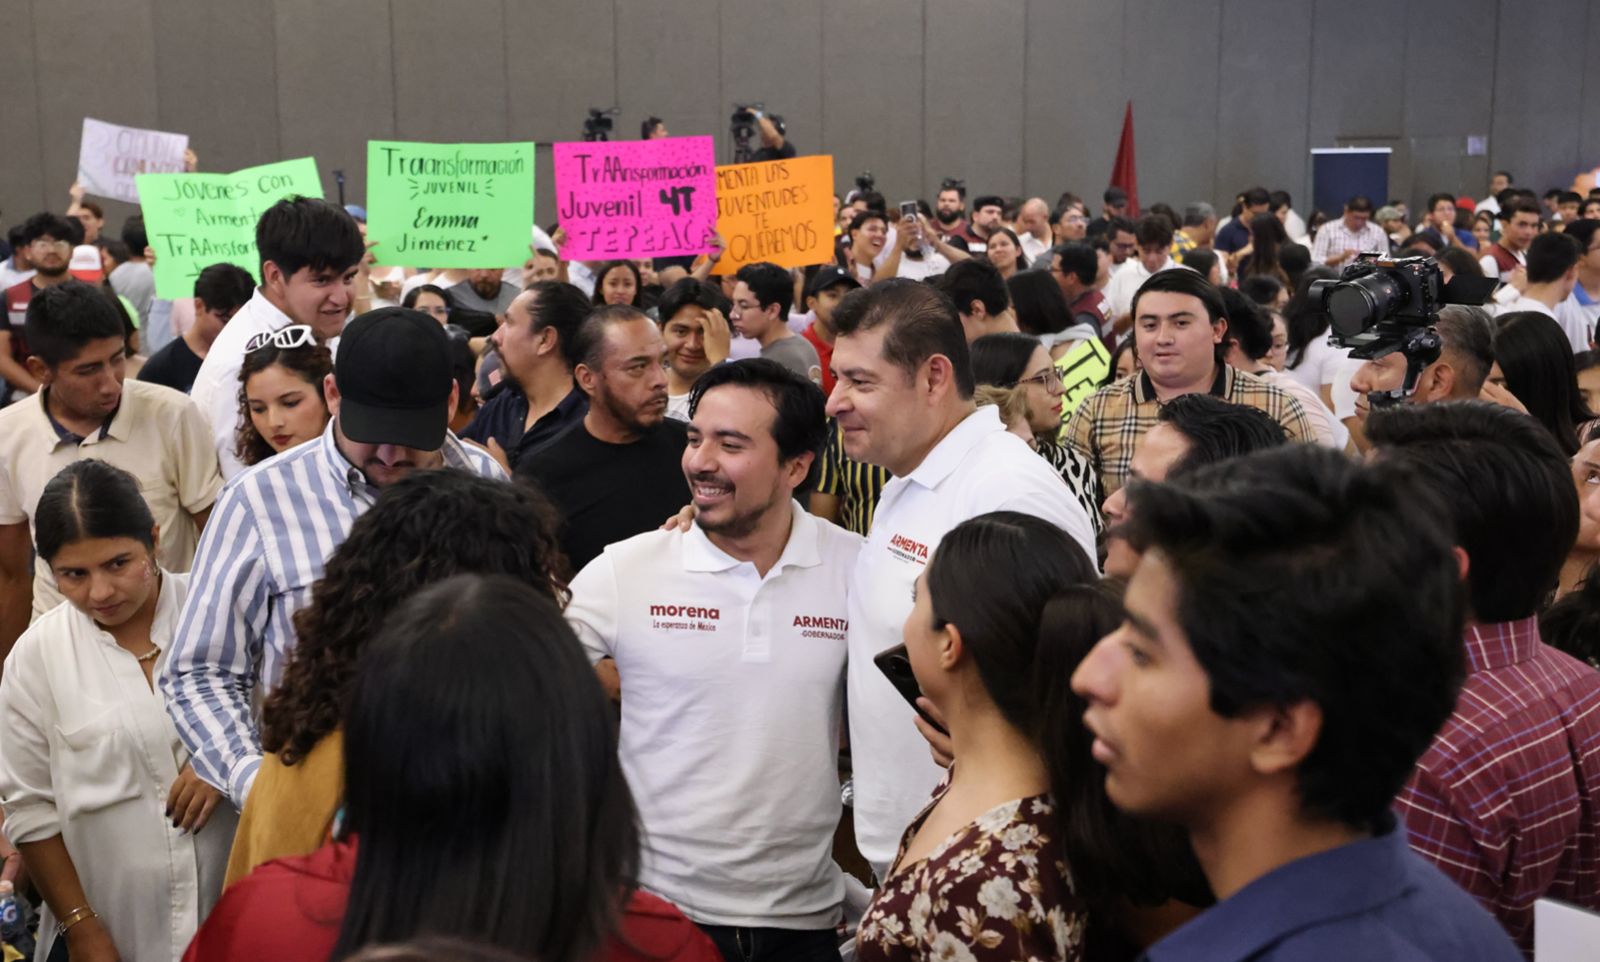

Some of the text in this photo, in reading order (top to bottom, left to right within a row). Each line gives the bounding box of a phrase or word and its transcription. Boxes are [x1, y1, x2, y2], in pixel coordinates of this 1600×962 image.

[765, 162, 790, 183] LAS
[423, 181, 479, 194] JUVENIL
[561, 186, 697, 219] Juvenil 4T
[716, 185, 809, 220] JUVENTUDES
[413, 206, 479, 229] Emma
[752, 212, 770, 230] TE
[396, 233, 477, 252] Jiménez
[729, 220, 817, 263] QUEREMOS
[890, 533, 928, 559] ARMENTA
[650, 605, 720, 620] morena
[689, 621, 696, 630] de
[802, 630, 845, 641] GOBERNADOR
